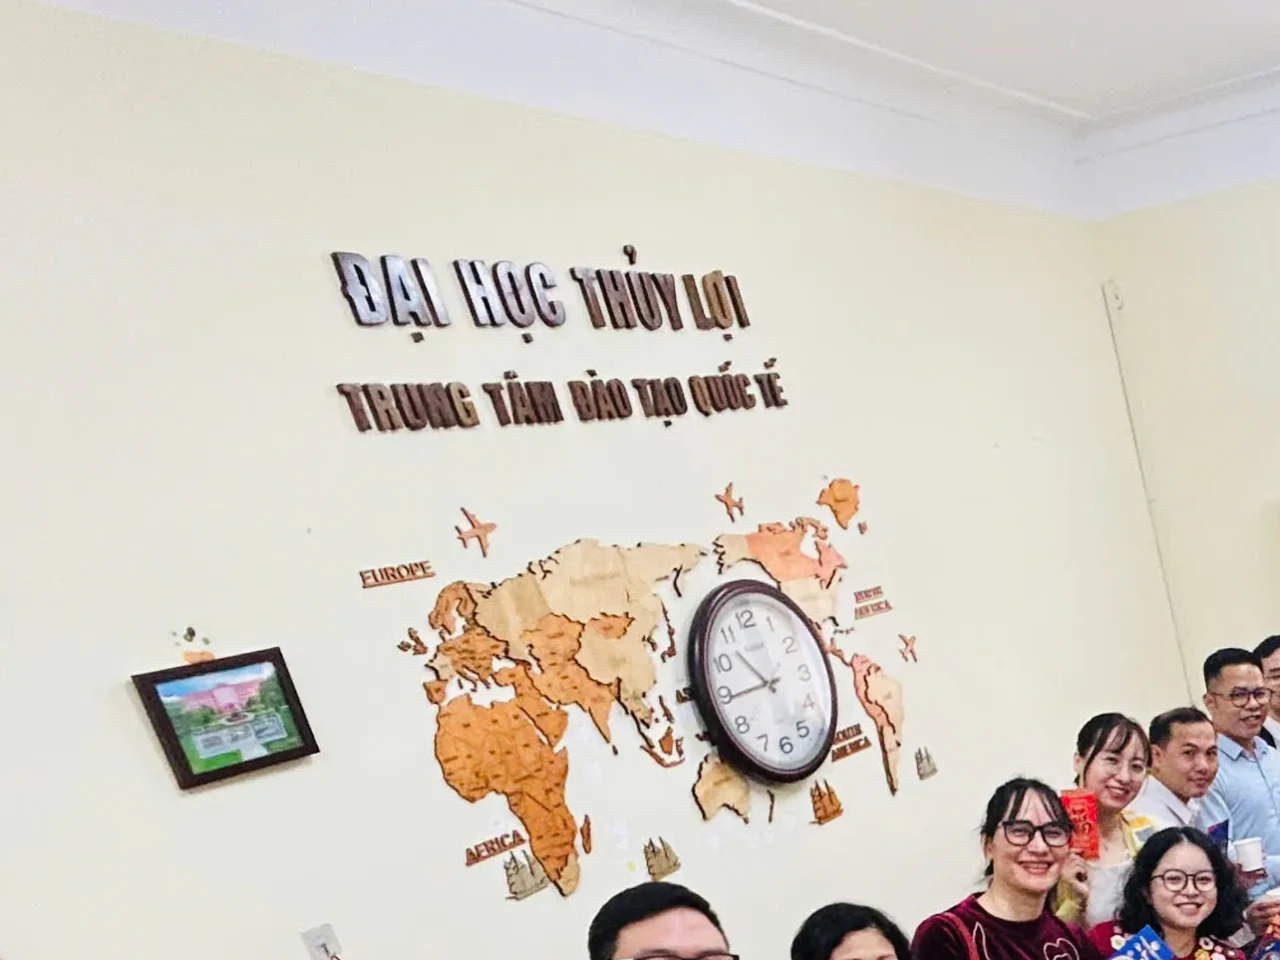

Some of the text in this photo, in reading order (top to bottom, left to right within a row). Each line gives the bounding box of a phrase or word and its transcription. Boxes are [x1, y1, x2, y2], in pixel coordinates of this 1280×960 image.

[331, 244, 751, 343] ĐẠI HỌC THỦY LỢI
[336, 357, 788, 432] TRUNG TÂM ĐÀO TẠO QUỐC TẾ
[359, 560, 435, 588] EUROPE
[735, 610, 756, 628] 12
[766, 616, 775, 632] 1
[720, 626, 736, 644] 11
[782, 636, 798, 654] 2
[713, 653, 732, 673] 10
[798, 664, 812, 681] 3
[717, 686, 732, 704] 9
[801, 695, 816, 709] 4
[735, 716, 750, 734] 8
[796, 720, 810, 738] 5
[757, 734, 769, 752] 7
[779, 736, 793, 754] 6
[465, 829, 526, 866] AFRICA
